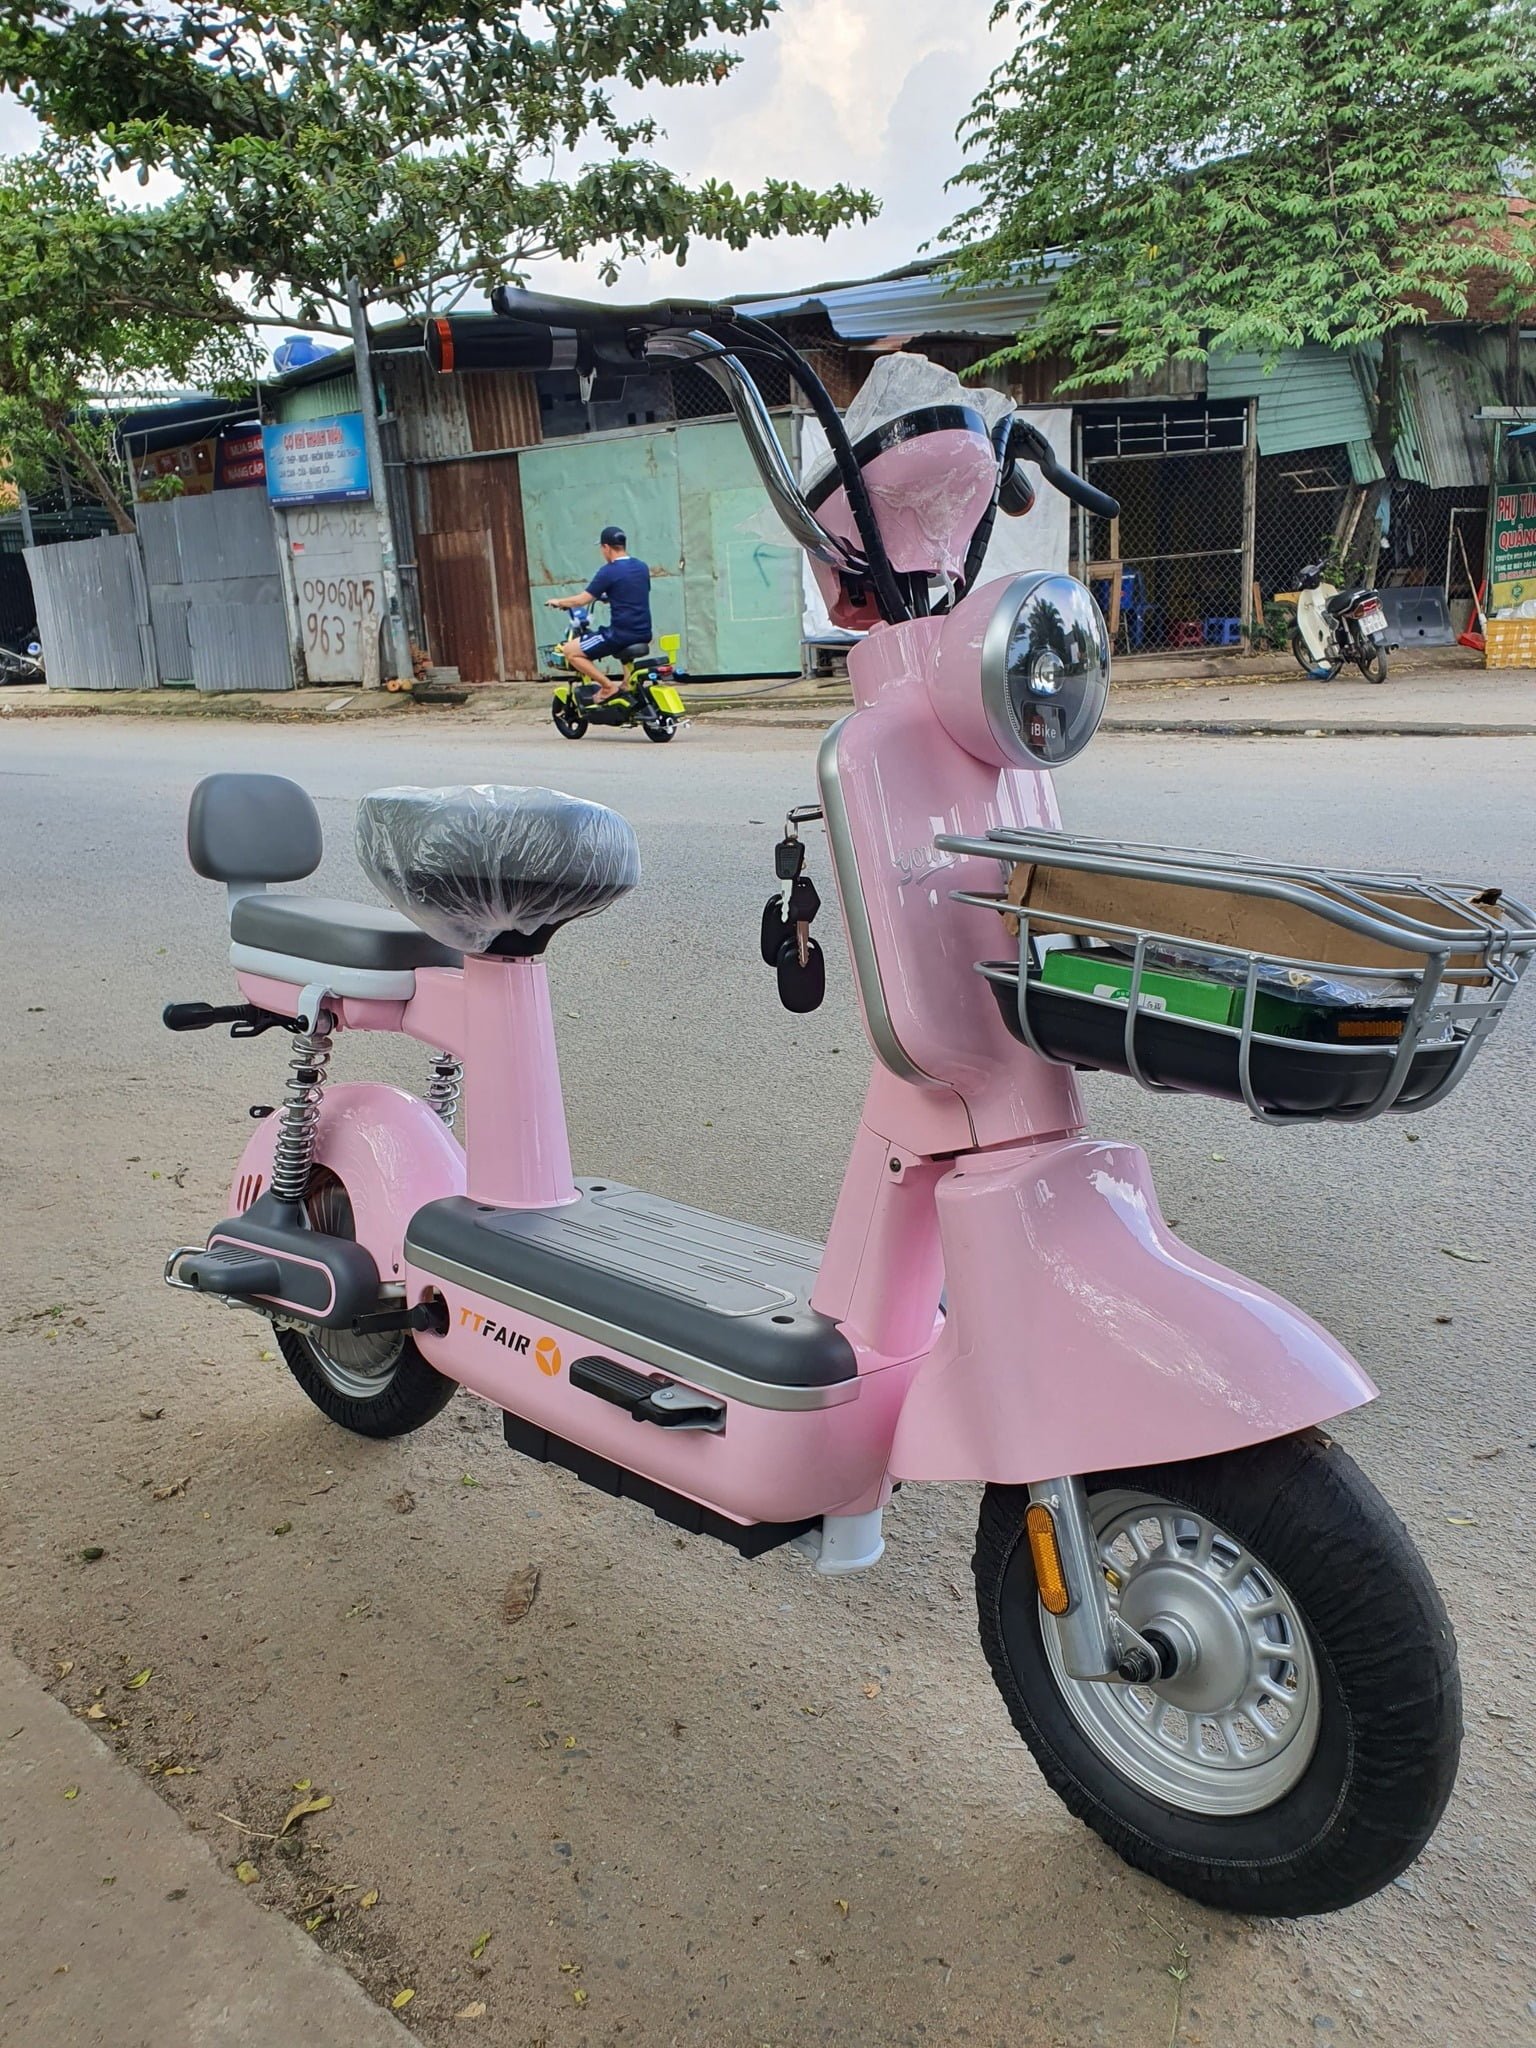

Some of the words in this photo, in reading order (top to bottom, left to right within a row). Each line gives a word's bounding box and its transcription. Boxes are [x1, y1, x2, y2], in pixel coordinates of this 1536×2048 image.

[1497, 495, 1518, 525] PHỤ
[1031, 723, 1057, 738] iBike
[459, 1306, 531, 1355] TTFAIR
